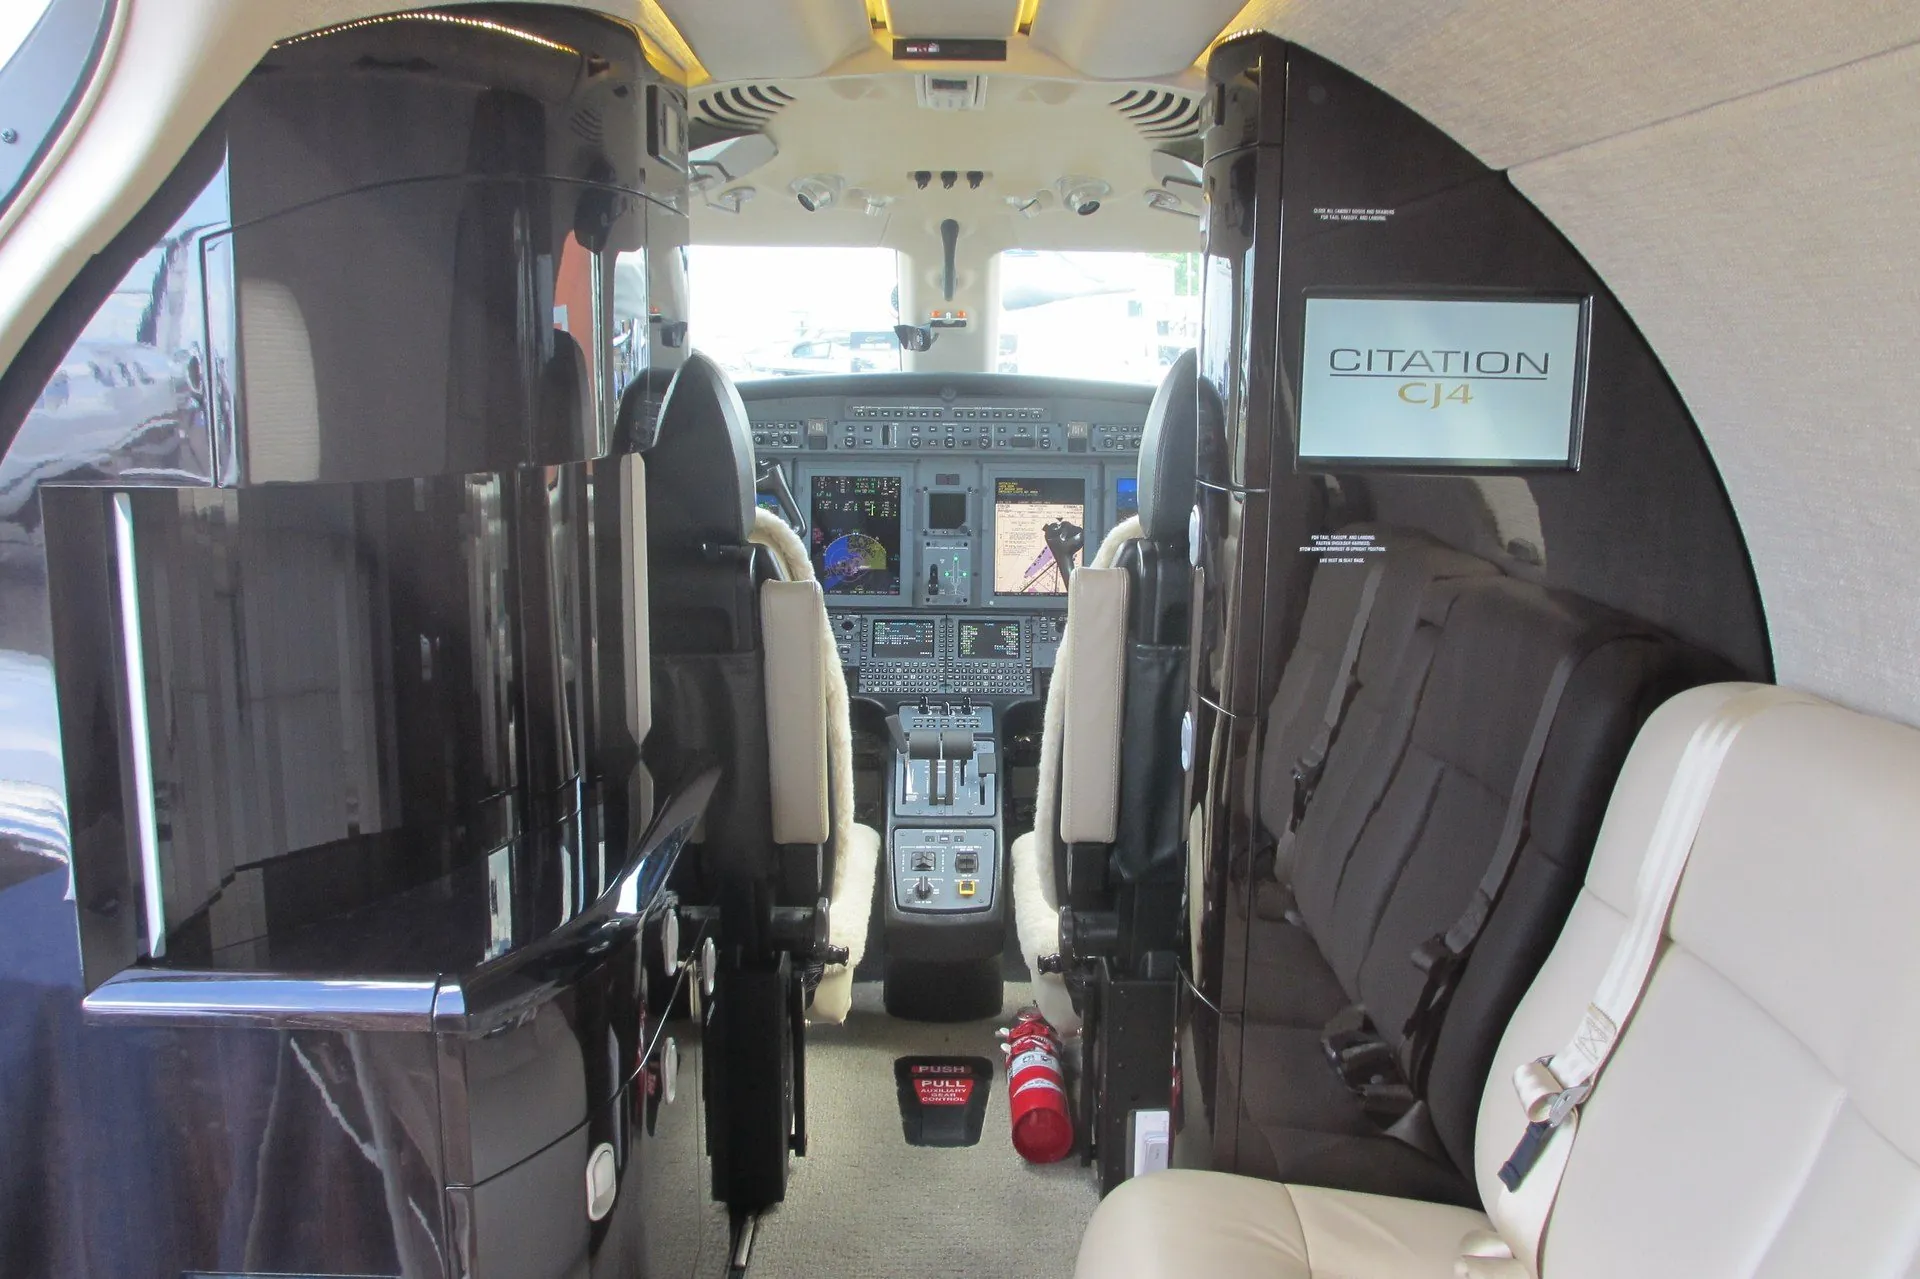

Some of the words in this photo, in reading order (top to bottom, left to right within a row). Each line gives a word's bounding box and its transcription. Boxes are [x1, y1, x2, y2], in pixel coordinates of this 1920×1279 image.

[1329, 348, 1550, 375] CITATION
[1397, 382, 1473, 409] CJ4
[918, 1065, 965, 1073] PUSH
